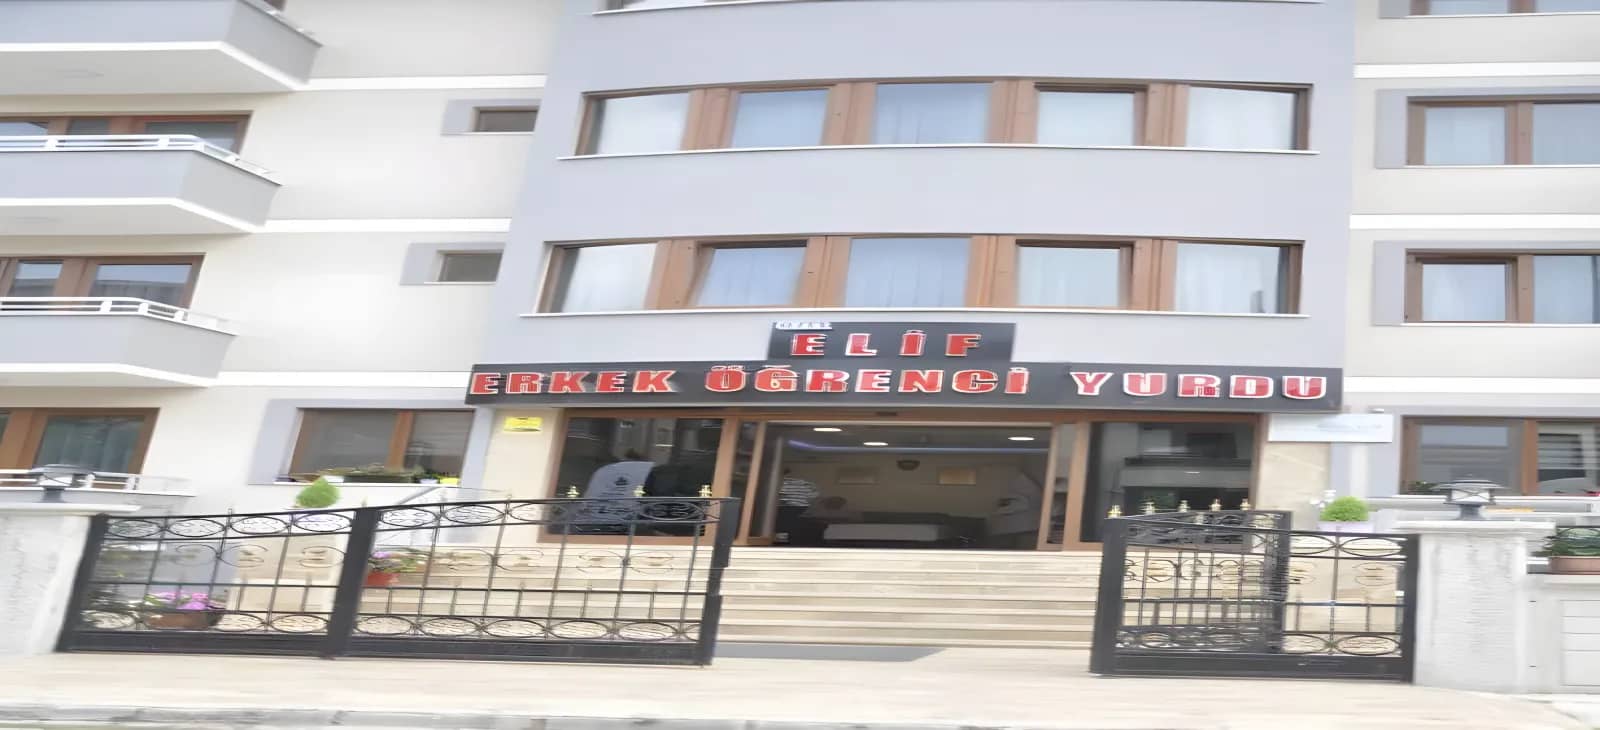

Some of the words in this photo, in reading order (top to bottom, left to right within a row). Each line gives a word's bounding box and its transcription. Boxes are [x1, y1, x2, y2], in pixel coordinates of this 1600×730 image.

[791, 329, 982, 357] ELİF
[469, 371, 675, 396] ERKEK
[705, 364, 1030, 394] ÖĞRENCİ
[1069, 371, 1328, 400] YURDU
